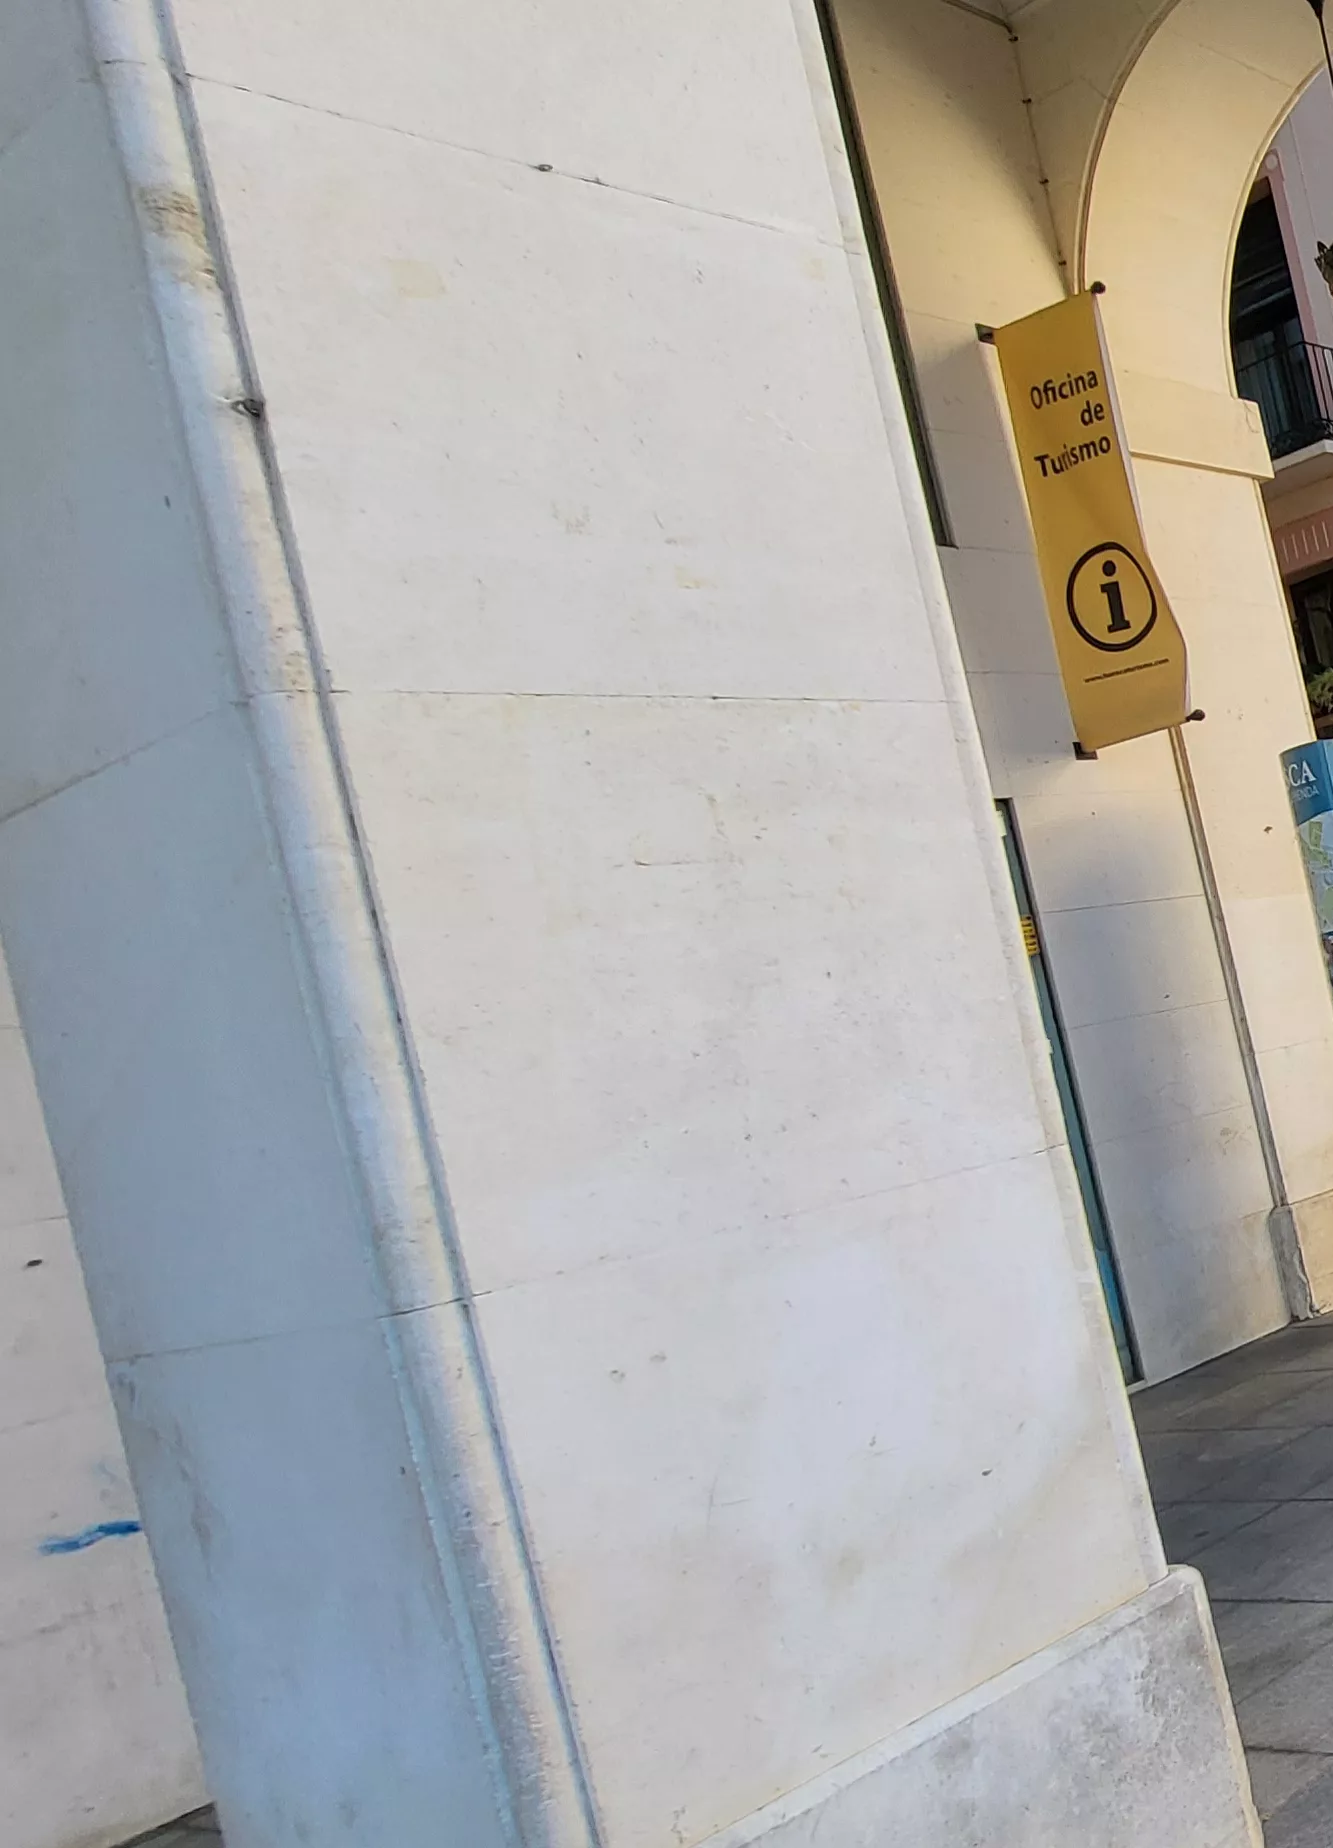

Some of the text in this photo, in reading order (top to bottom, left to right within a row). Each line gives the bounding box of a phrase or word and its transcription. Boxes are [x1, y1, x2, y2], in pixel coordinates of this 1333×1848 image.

[1030, 370, 1099, 410] Oficina
[1080, 400, 1105, 427] de
[1033, 435, 1111, 478] Turismo
